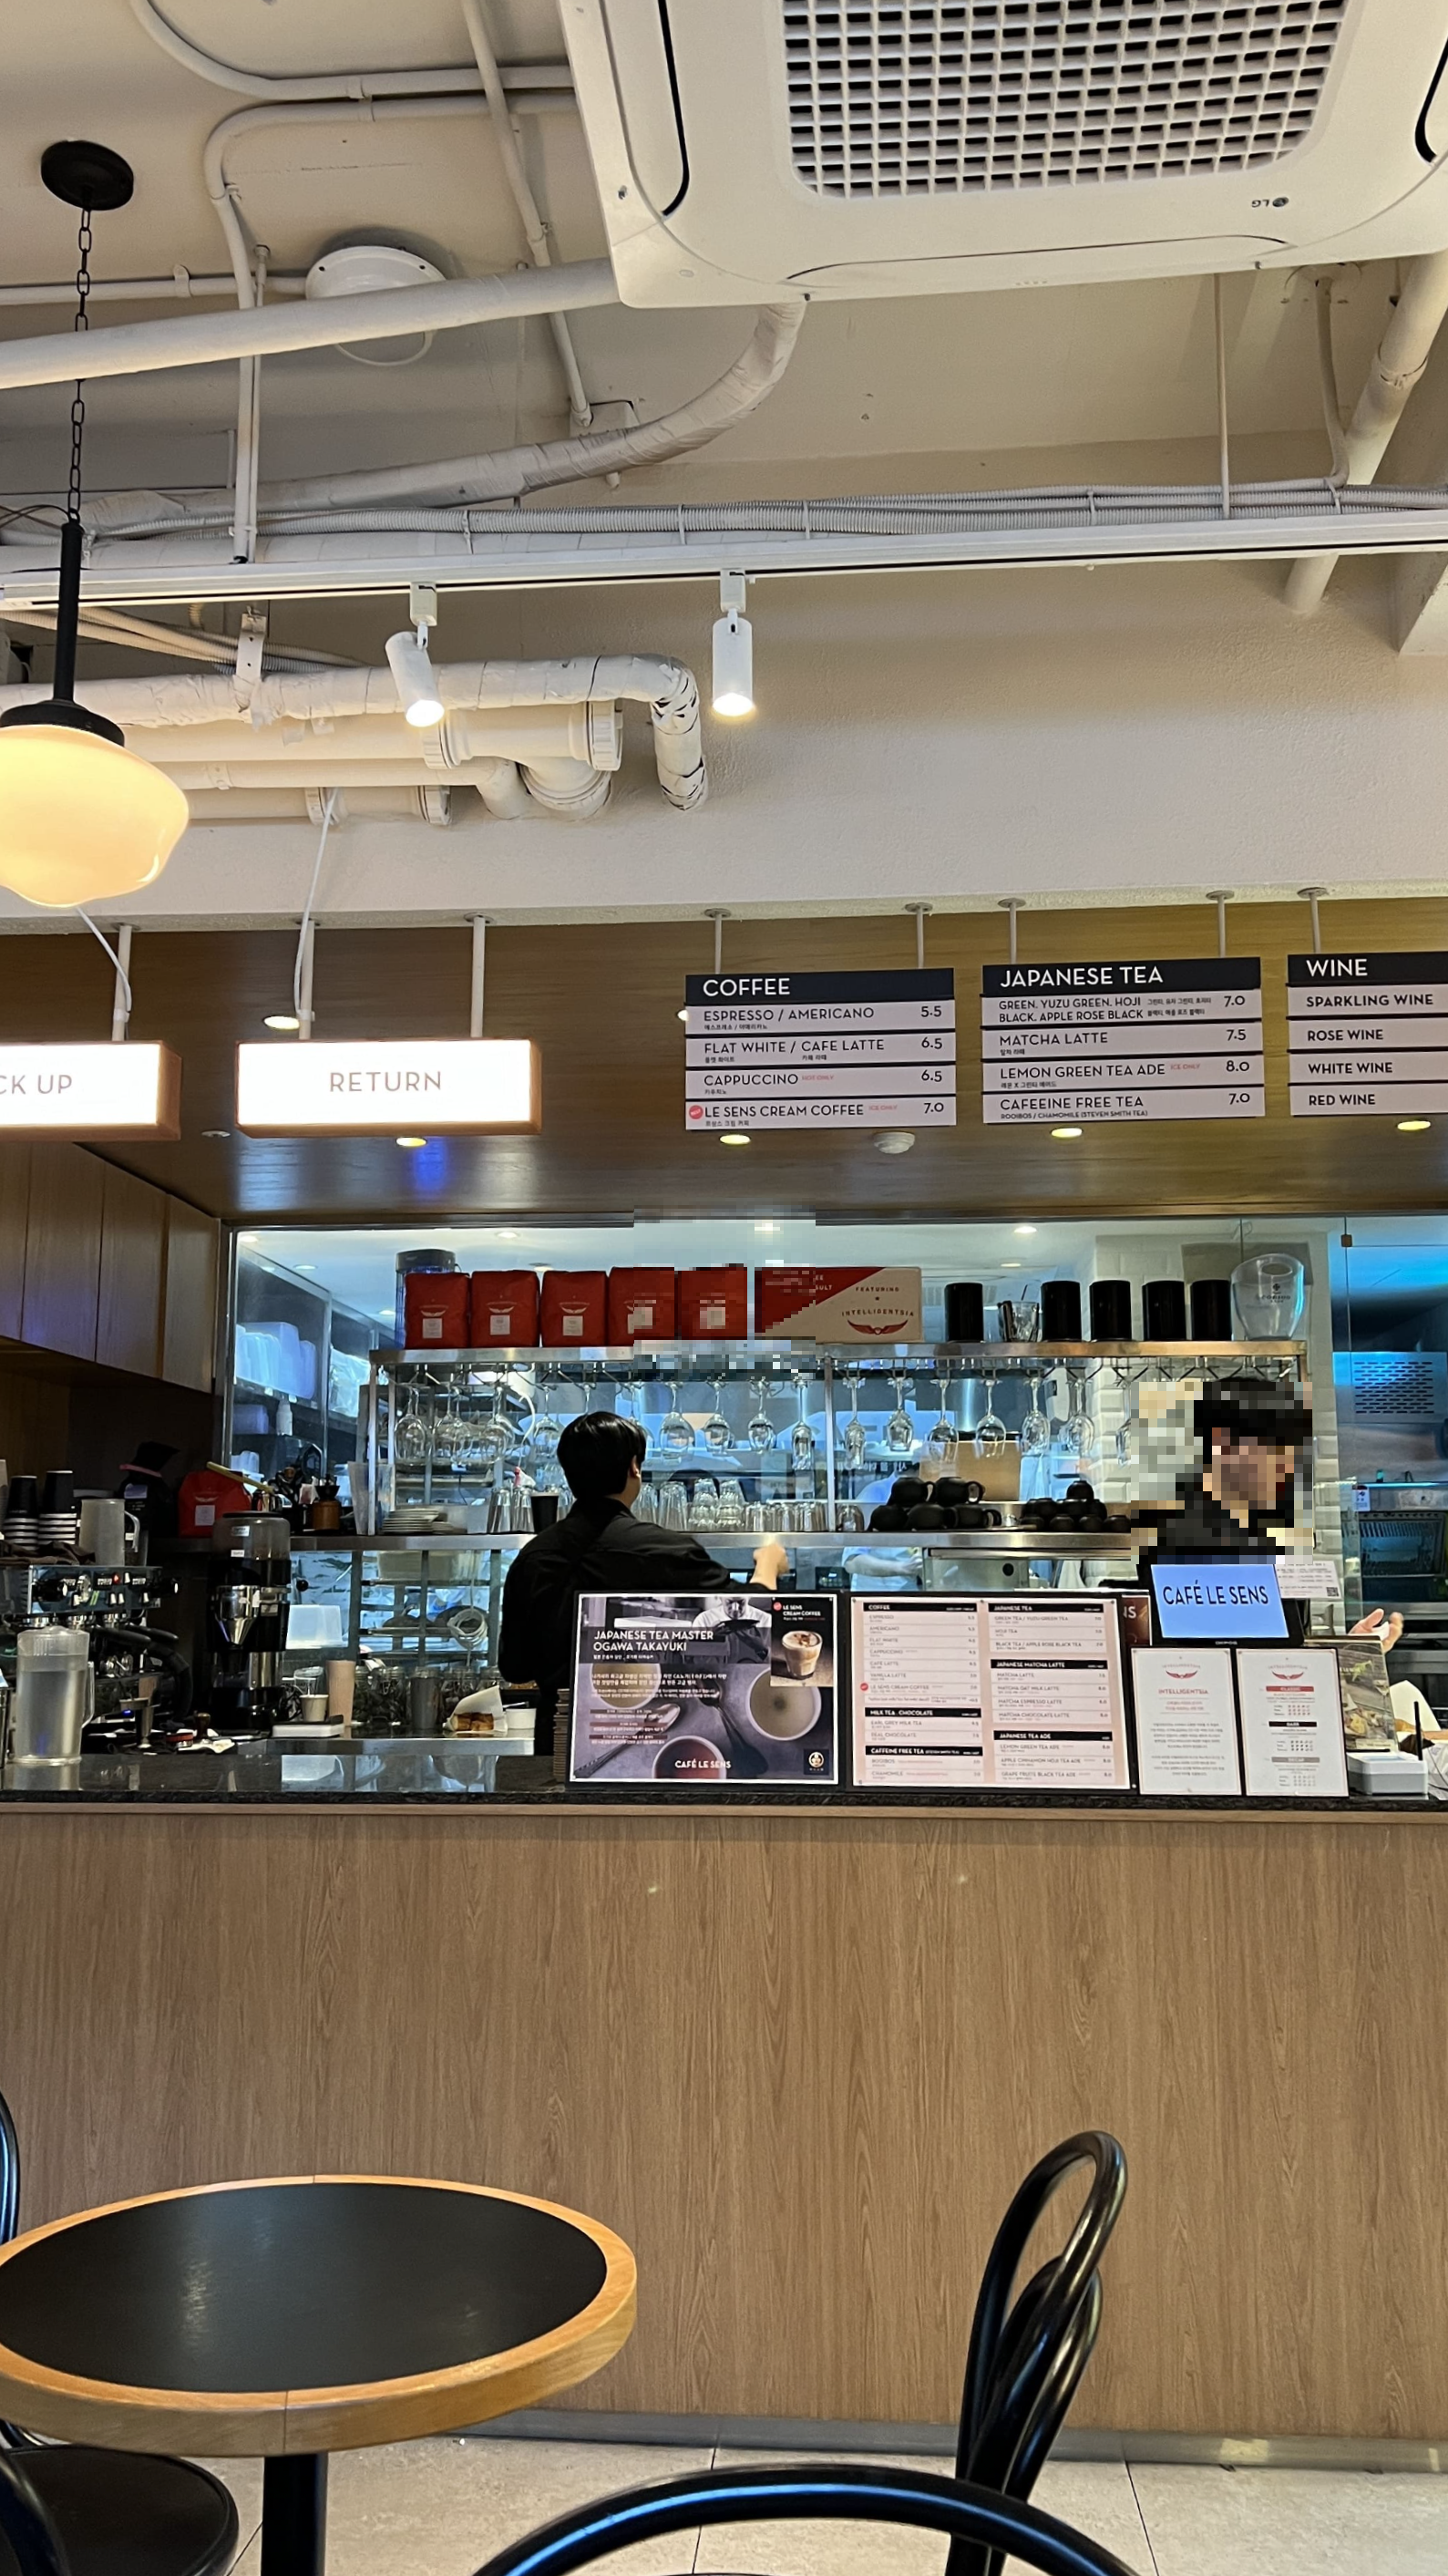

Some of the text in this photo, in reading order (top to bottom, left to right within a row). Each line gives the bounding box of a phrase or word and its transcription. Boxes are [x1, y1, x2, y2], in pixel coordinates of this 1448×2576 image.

[1306, 958, 1368, 977] WINE
[1001, 965, 1164, 988] JAPANESE TEA
[703, 978, 791, 996] COFFEE
[1041, 999, 1070, 1009] YUZU
[1115, 997, 1141, 1006] HOJI
[1223, 995, 1246, 1007] 7.0
[1306, 994, 1433, 1007] SPARKLING WINE
[703, 1009, 774, 1022] ESPRESSO
[788, 1007, 874, 1020] AMERICANO
[920, 1005, 942, 1018] 5.5
[1040, 1012, 1073, 1022] APPLE
[1076, 1011, 1104, 1020] ROSE
[1108, 1009, 1144, 1019] BLACK
[1000, 1029, 1247, 1046] MATCHA LATTE 7.5
[1307, 1029, 1383, 1041] ROSE WINE
[704, 1042, 737, 1054] FLAT
[741, 1041, 786, 1053] WHITE
[801, 1040, 837, 1052] CAFE
[842, 1039, 885, 1051] LATTE
[920, 1036, 943, 1049] 6.5
[1001, 1067, 1051, 1079] LEMON
[1054, 1066, 1103, 1077] GREEN
[1106, 1065, 1133, 1077] TEA
[1136, 1064, 1166, 1076] ADE
[1226, 1060, 1250, 1072] 8.0
[1309, 1062, 1393, 1074] WHITE WINE
[37, 1074, 72, 1095] UP
[329, 1071, 441, 1092] RETURN
[703, 1074, 798, 1086] CAPPUCCINO
[920, 1069, 943, 1083] 6.5
[1076, 1097, 1112, 1108] FREE
[1115, 1096, 1144, 1108] TEA
[1228, 1093, 1250, 1105] 7.0
[1309, 1094, 1376, 1106] RED WINE
[704, 1107, 720, 1118] LE
[724, 1106, 756, 1118] SENS
[760, 1106, 806, 1117] CREAM
[810, 1105, 864, 1116] COFFEE
[923, 1102, 945, 1114] 7.0
[1163, 1580, 1268, 1605] CAFÉ LE SENS
[594, 1630, 714, 1640] JAPANESE TEA MASTER
[593, 1642, 687, 1652] OGAWA TAKAYUKI
[674, 1758, 732, 1768] CAFÉ LE SENS
